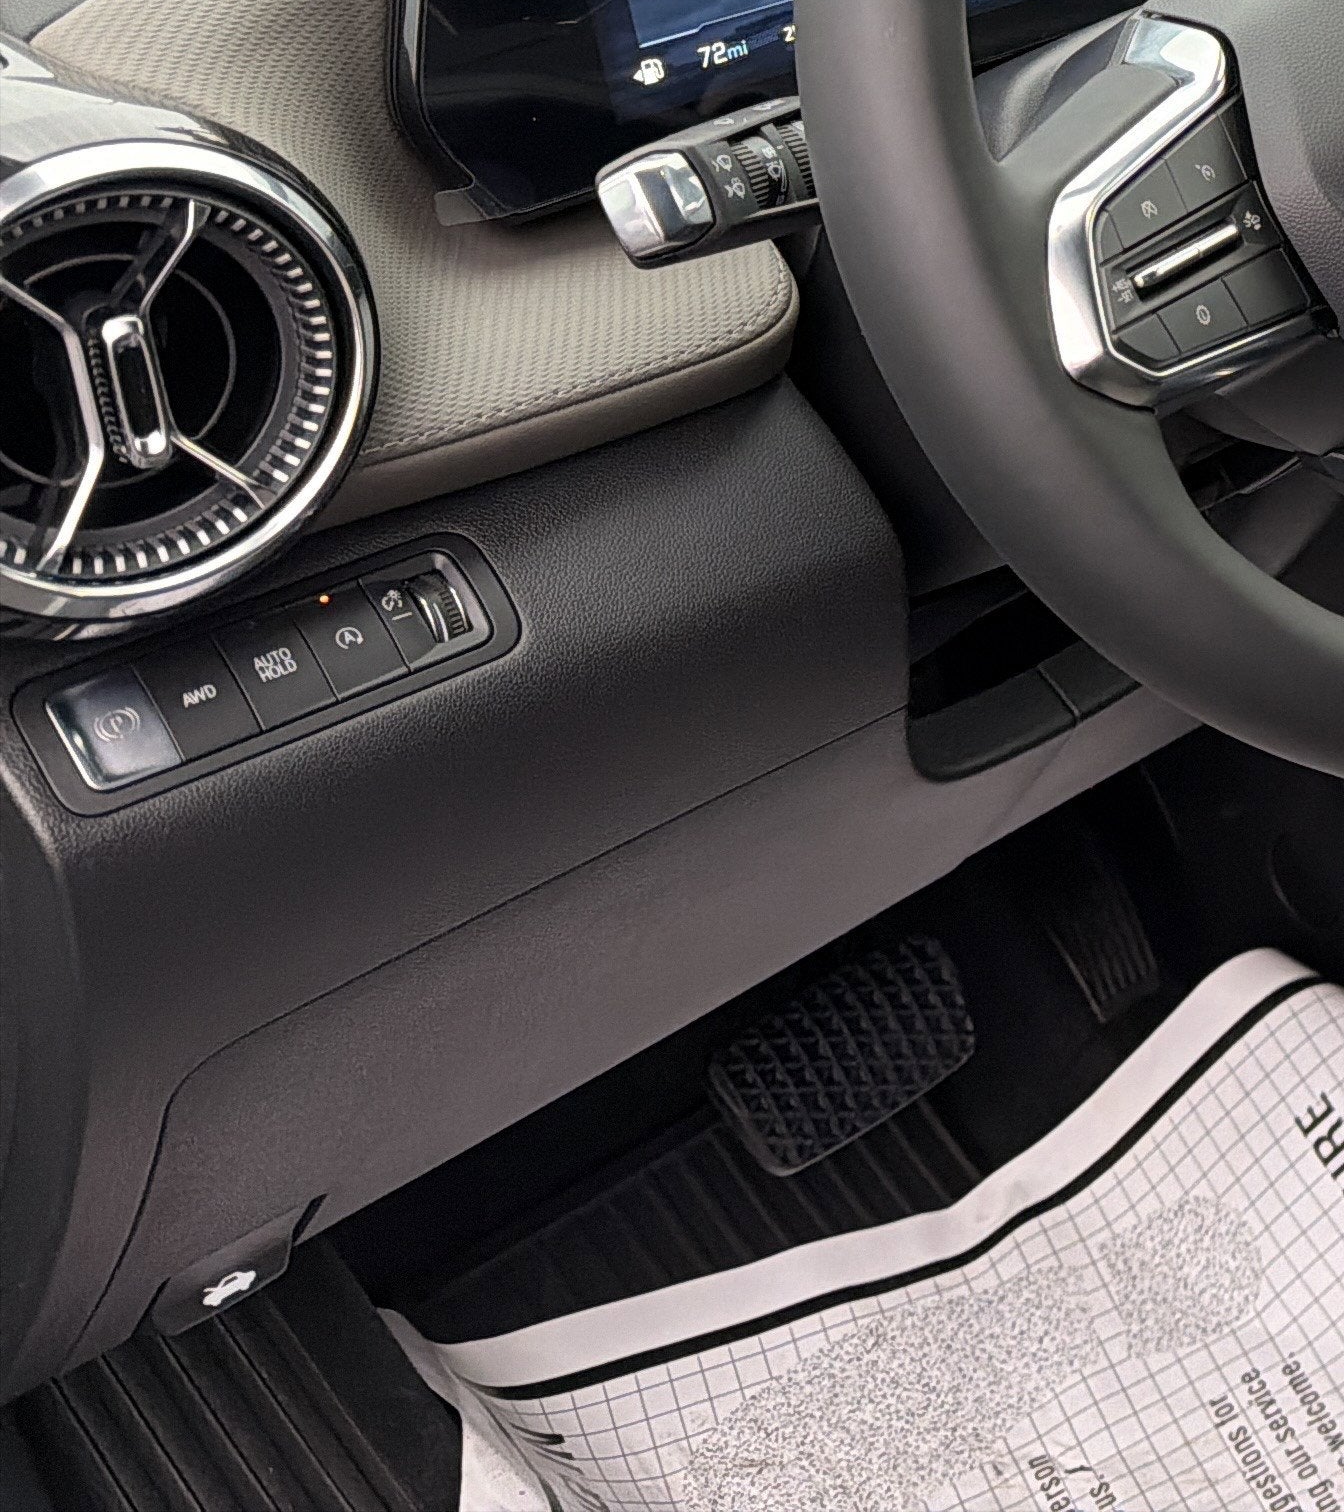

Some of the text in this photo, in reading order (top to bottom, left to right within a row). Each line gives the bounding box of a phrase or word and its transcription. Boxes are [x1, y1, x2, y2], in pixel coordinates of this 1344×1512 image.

[697, 39, 749, 69] 72mi
[253, 647, 291, 670] AUTO
[258, 658, 298, 684] HOLD
[181, 683, 217, 709] AWD
[1241, 1367, 1295, 1443] service
[1285, 1445, 1318, 1480] our
